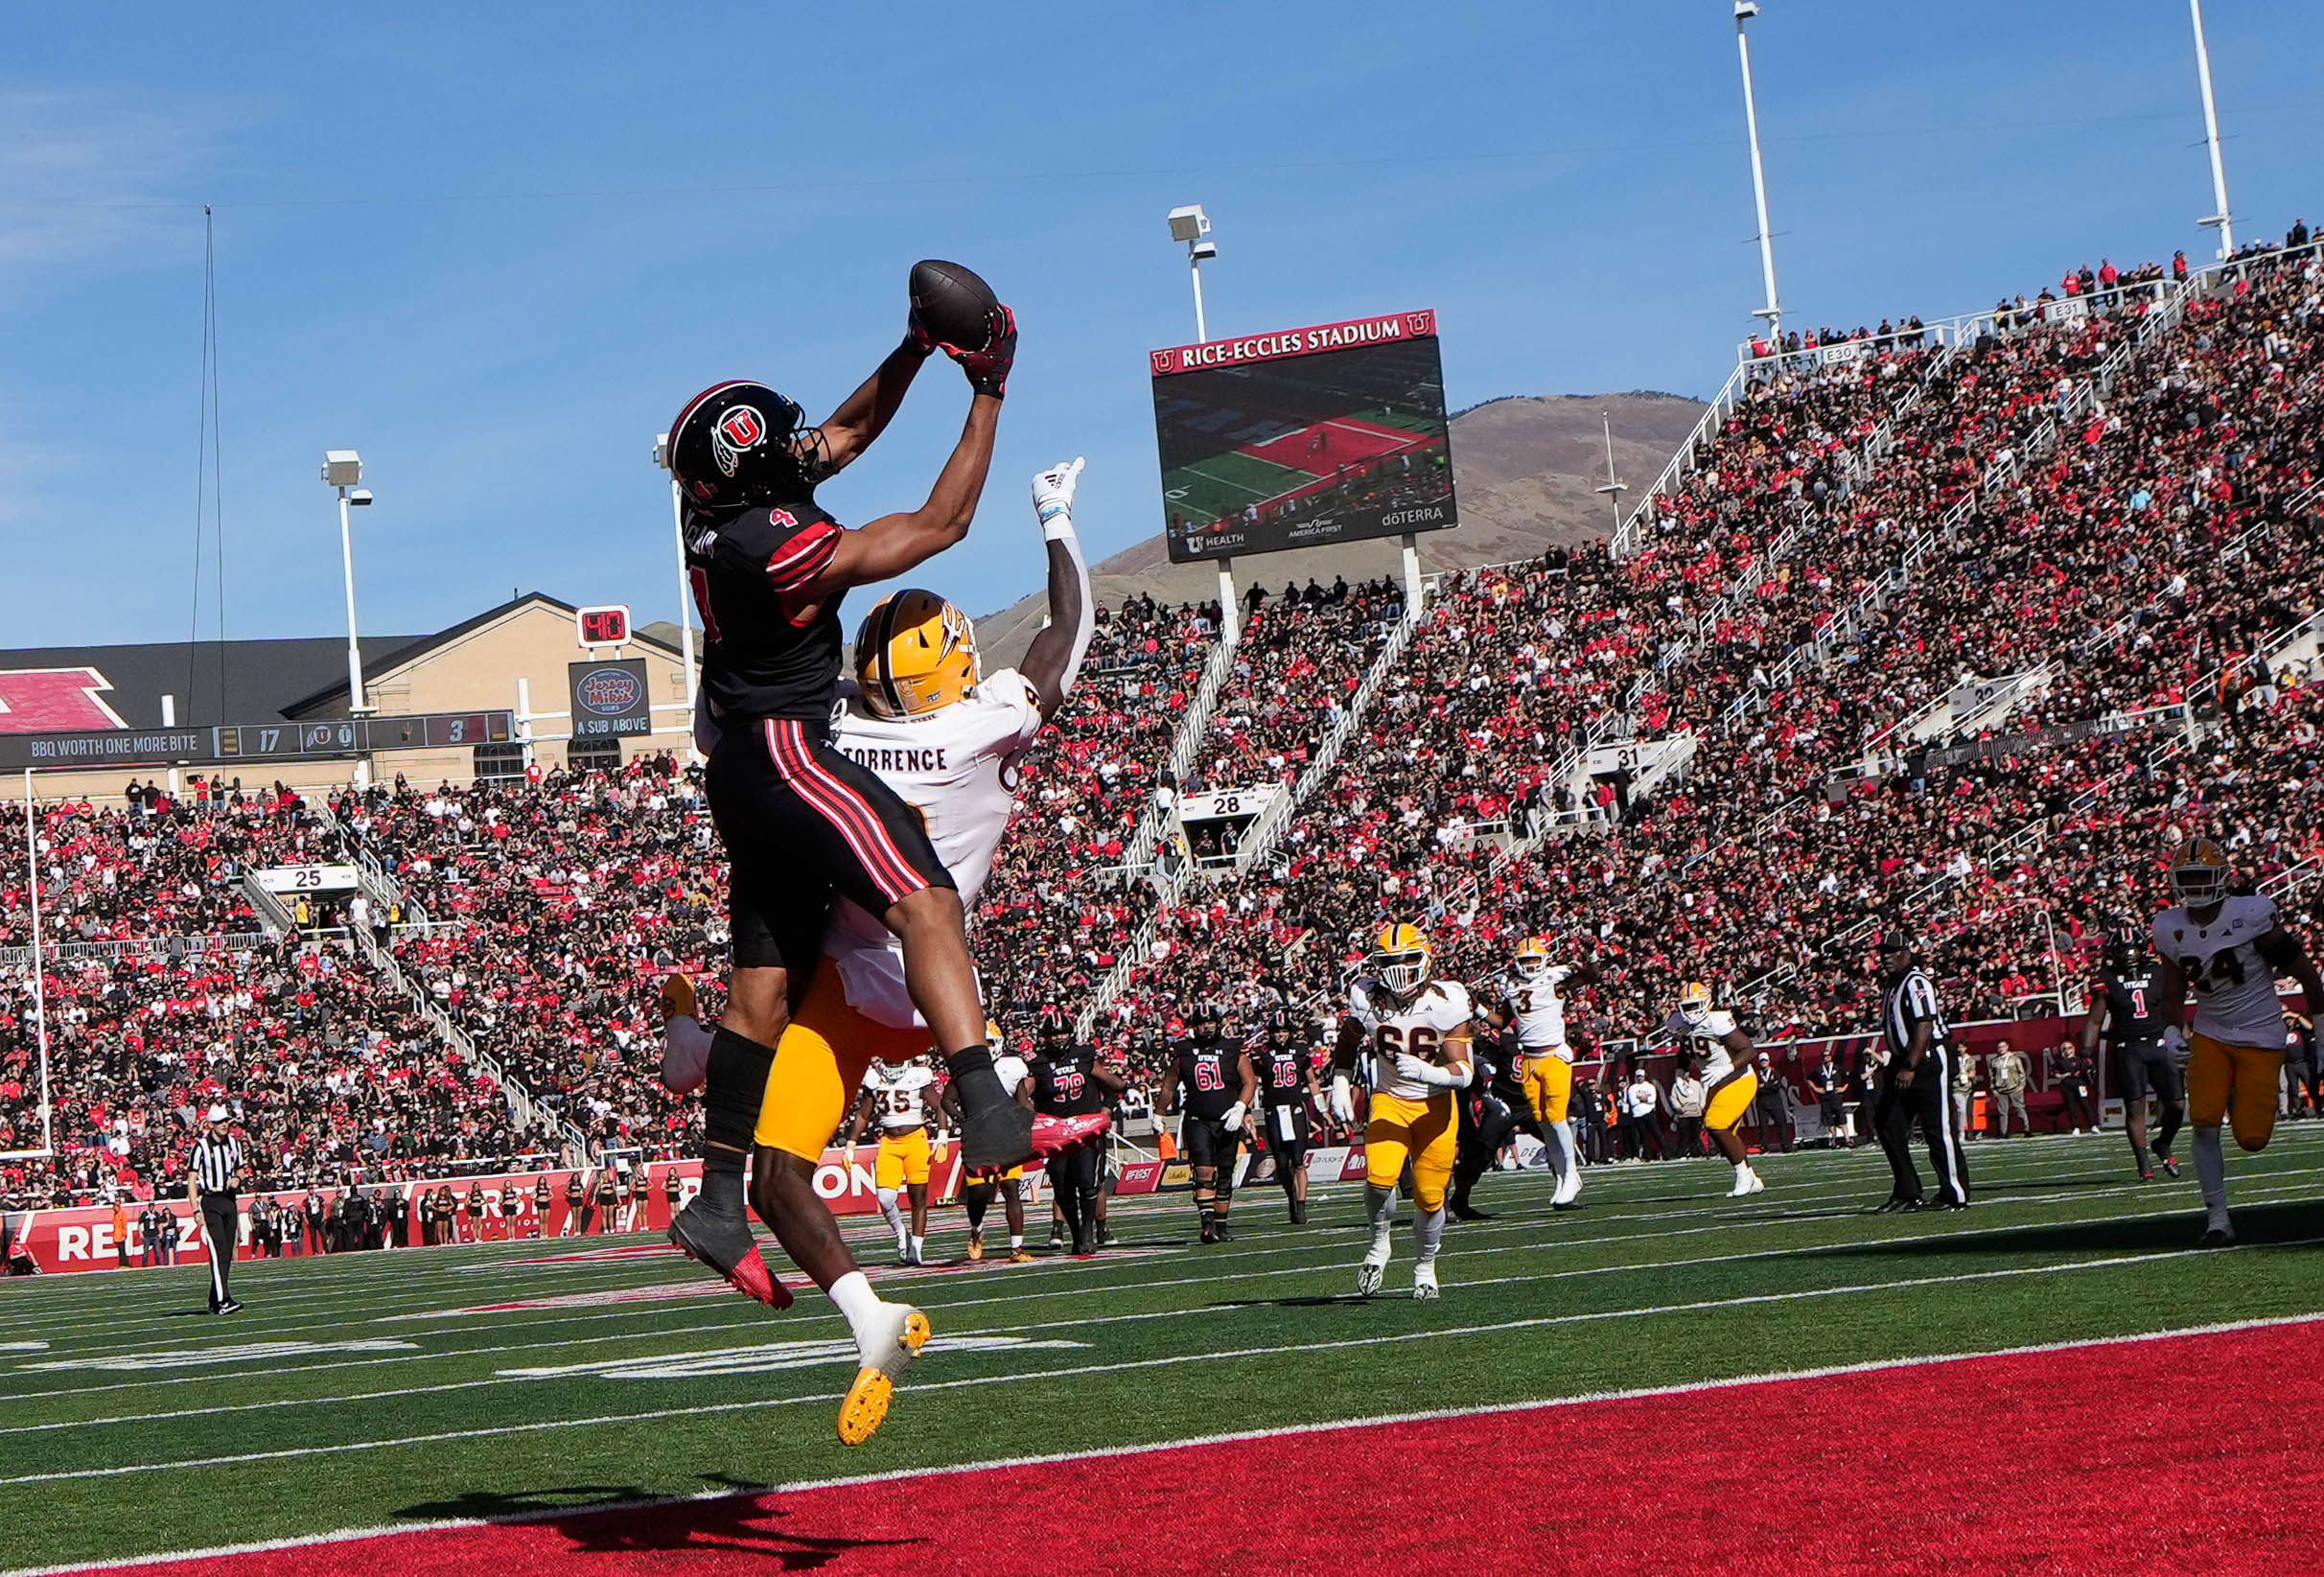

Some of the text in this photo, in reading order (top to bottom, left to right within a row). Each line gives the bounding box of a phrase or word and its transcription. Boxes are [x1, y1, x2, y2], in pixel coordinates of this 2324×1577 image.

[2056, 303, 2078, 316] E31
[1406, 312, 1431, 336] U
[1182, 319, 1401, 367] RICE-ECCLES STADIUM
[1827, 348, 1851, 360] E30
[1152, 351, 1174, 372] U
[721, 408, 760, 447] U
[769, 508, 799, 528] 4
[1206, 534, 1245, 547] HEALTH
[586, 613, 624, 640] 40
[585, 677, 634, 692] Jersey
[449, 720, 465, 742] 3
[577, 717, 647, 734] A SUB ABOVE
[31, 734, 198, 757] BBQ WORTH ONE MORE BITE
[260, 730, 280, 752] 17
[843, 747, 948, 772] TORRENCE
[1617, 748, 1638, 767] 31
[1214, 797, 1240, 815] 28
[295, 870, 321, 888] 25
[2131, 988, 2149, 1019] 1
[1376, 1025, 1438, 1063] 66
[1195, 1062, 1225, 1092] 61
[1272, 1061, 1297, 1088] 16
[876, 1090, 911, 1113] 35
